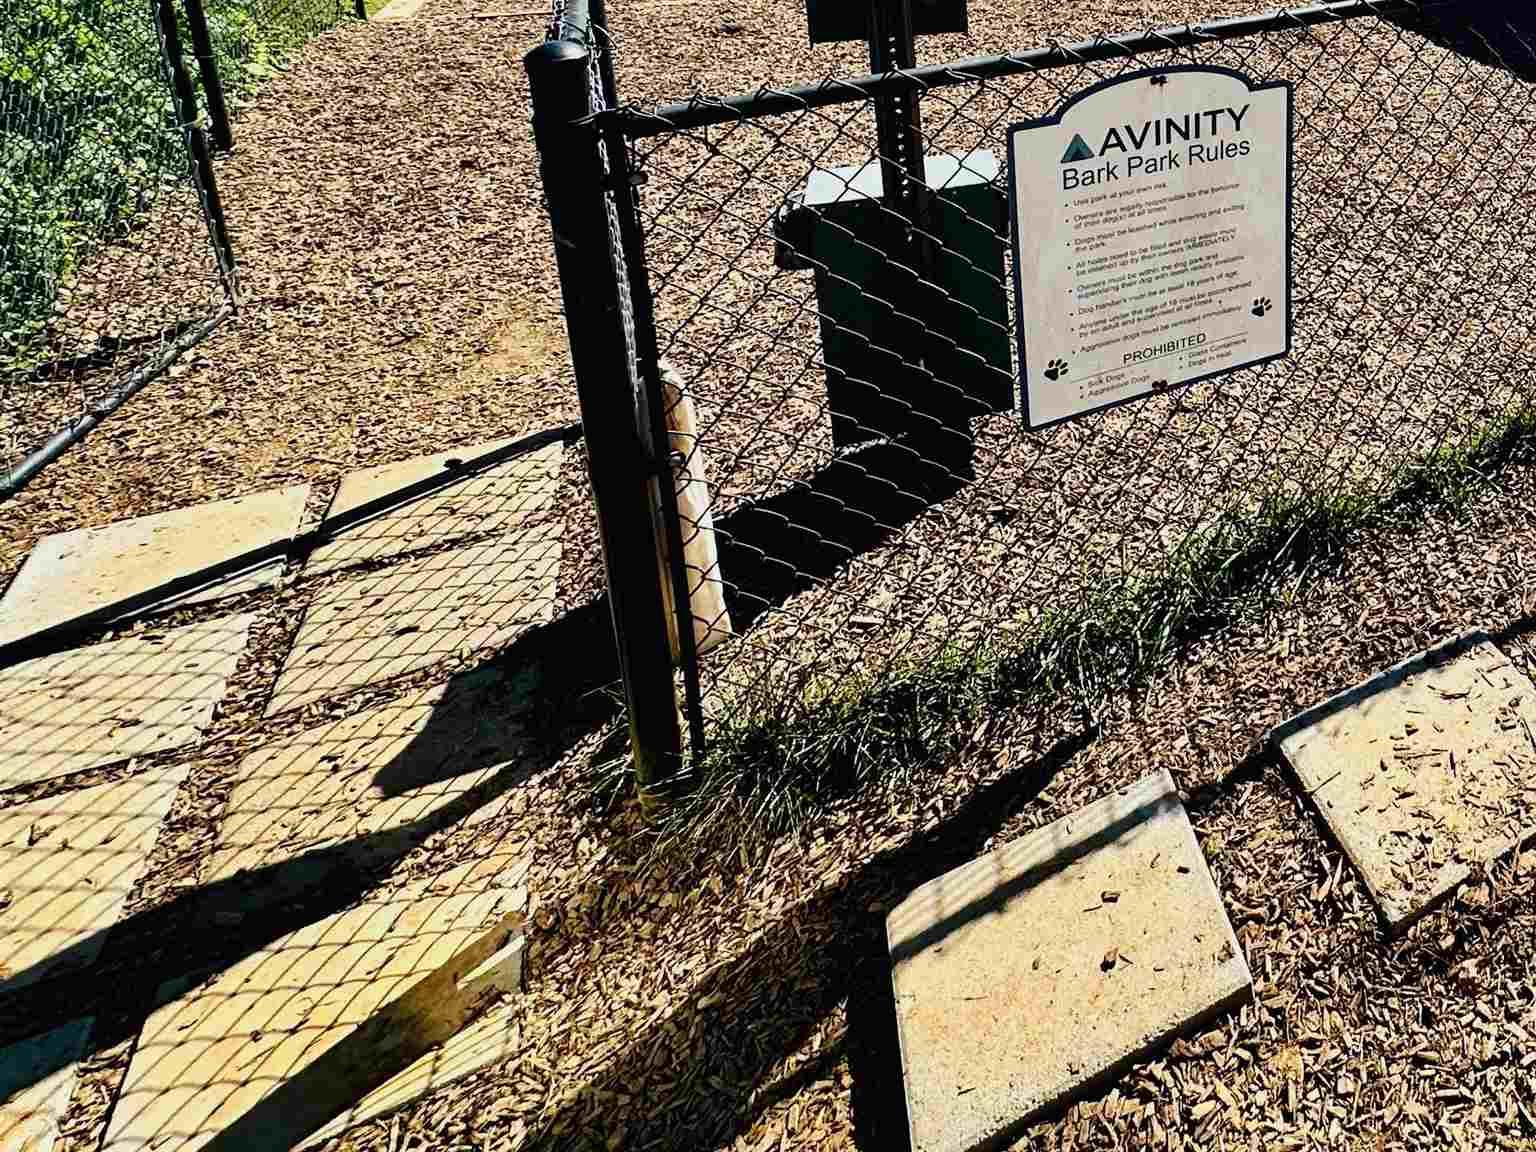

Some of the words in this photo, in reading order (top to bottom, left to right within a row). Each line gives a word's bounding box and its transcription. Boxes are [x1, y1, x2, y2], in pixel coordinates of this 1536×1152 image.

[1099, 104, 1250, 156] AVINITY
[1062, 164, 1119, 190] Bark
[1127, 151, 1181, 178] Park
[1188, 139, 1250, 166] Rules
[1123, 333, 1206, 364] PROHIBITED
